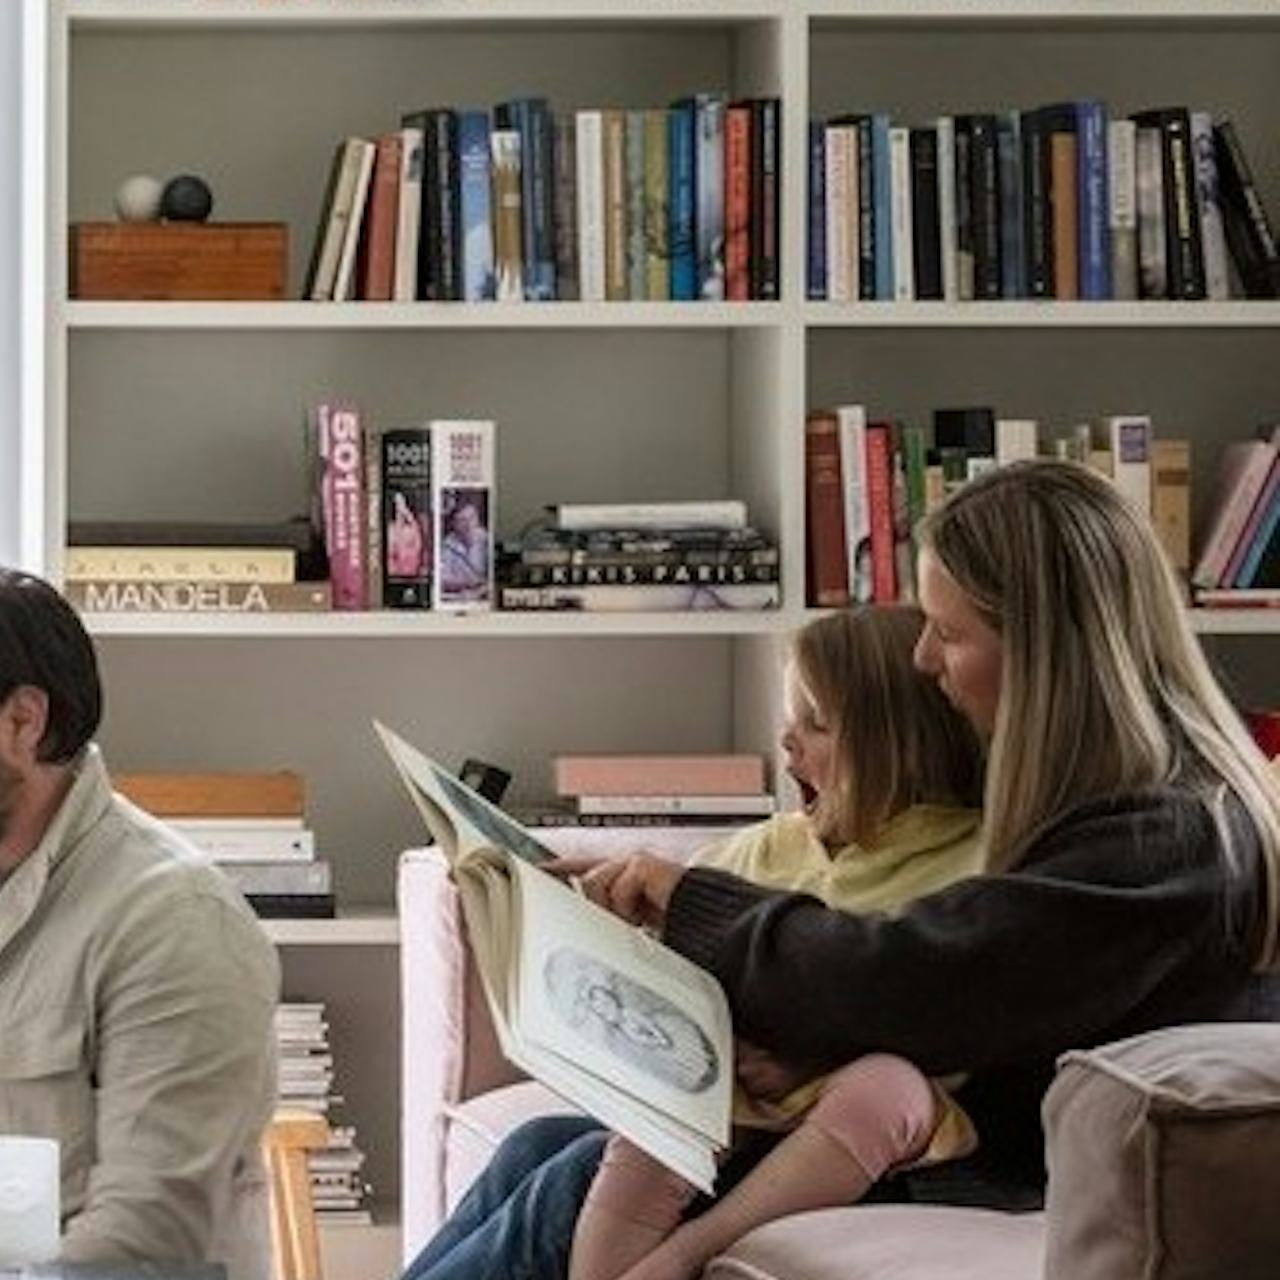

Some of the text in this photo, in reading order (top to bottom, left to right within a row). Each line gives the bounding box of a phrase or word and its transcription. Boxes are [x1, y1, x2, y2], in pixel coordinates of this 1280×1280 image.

[334, 411, 359, 492] 501
[387, 443, 429, 462] 1001
[654, 565, 746, 583] PARIS
[85, 583, 269, 611] MANDELA
